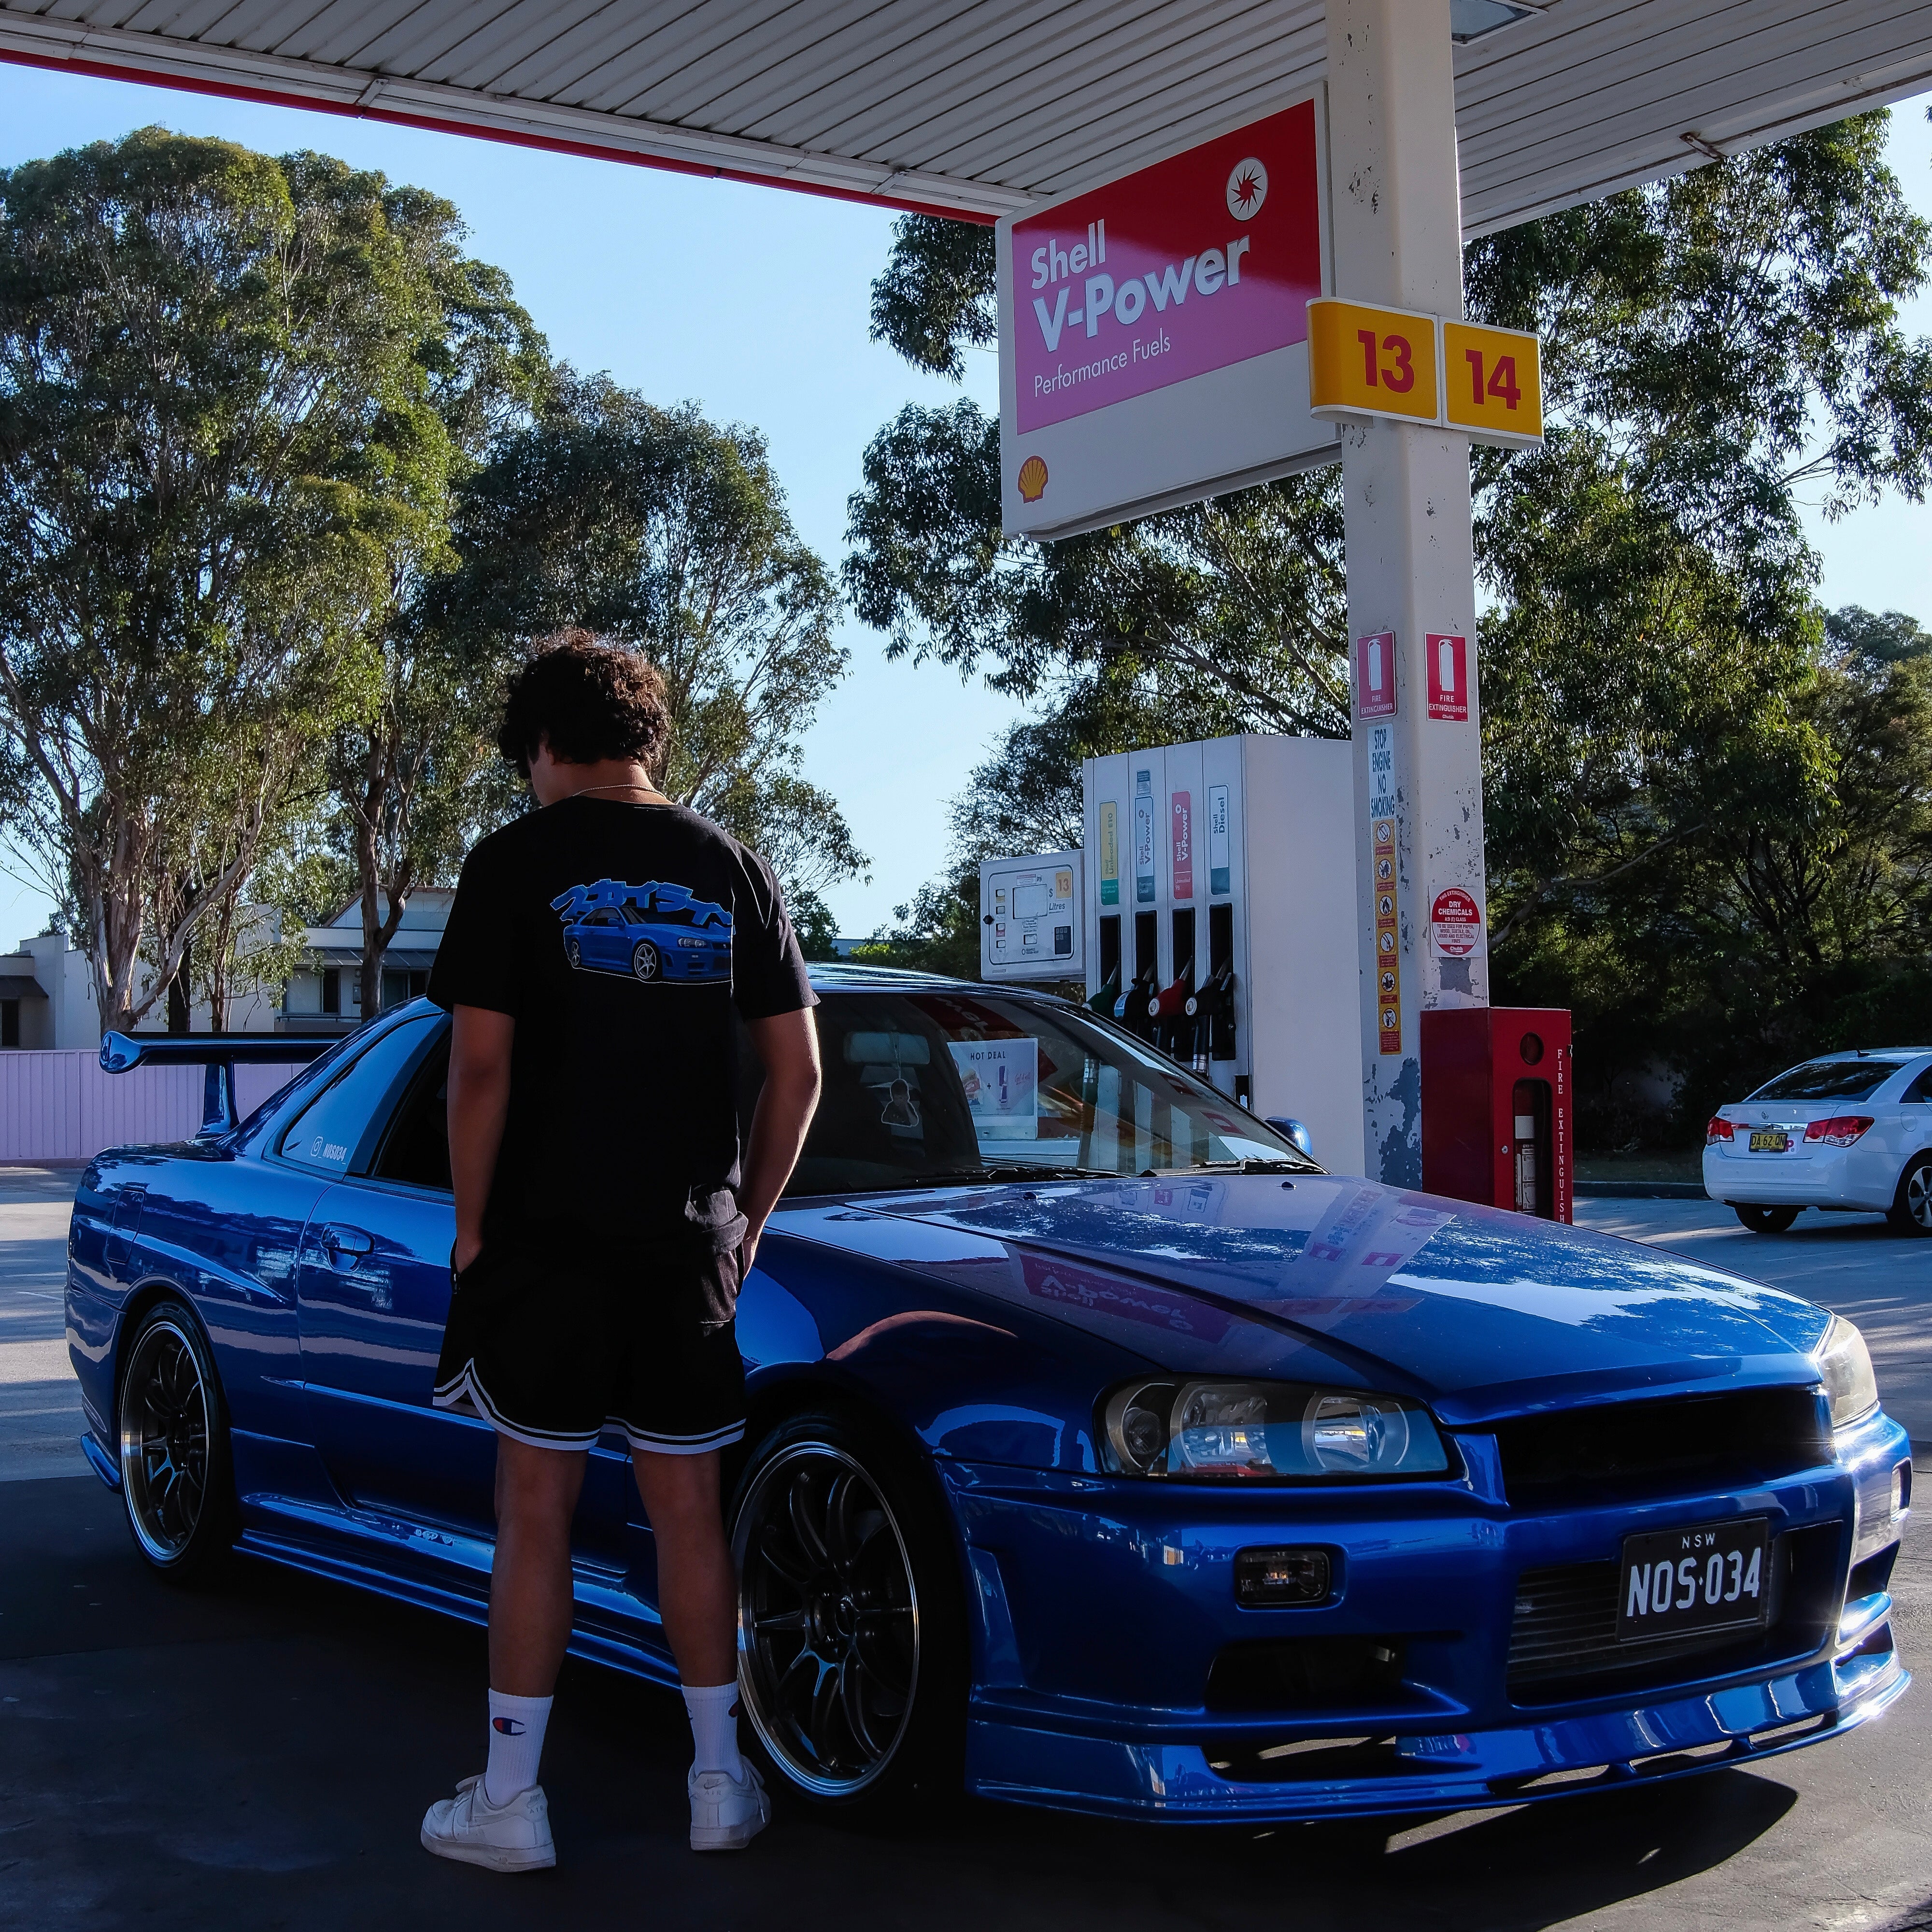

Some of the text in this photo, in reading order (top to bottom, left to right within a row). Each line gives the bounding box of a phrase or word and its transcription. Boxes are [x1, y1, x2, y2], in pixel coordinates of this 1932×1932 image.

[1031, 219, 1106, 289] Shell
[1033, 235, 1250, 353] V-Power
[1034, 328, 1171, 398] Performance Fuels
[1357, 329, 1415, 394] 13
[1465, 349, 1521, 411] 14
[1361, 703, 1393, 714] EXTINGUISHER
[1429, 703, 1467, 713] EXTINGUISHER
[1374, 728, 1387, 750] STOP
[1372, 750, 1391, 772] ENGINE
[1378, 773, 1386, 795] NO
[1371, 795, 1395, 818] SMOKING
[1049, 888, 1053, 898] $
[1058, 878, 1069, 892] 13
[970, 1051, 1006, 1060] HOT DEAL
[1751, 1135, 1761, 1146] DA
[1763, 1136, 1773, 1146] 62
[1681, 1533, 1716, 1549] NSW
